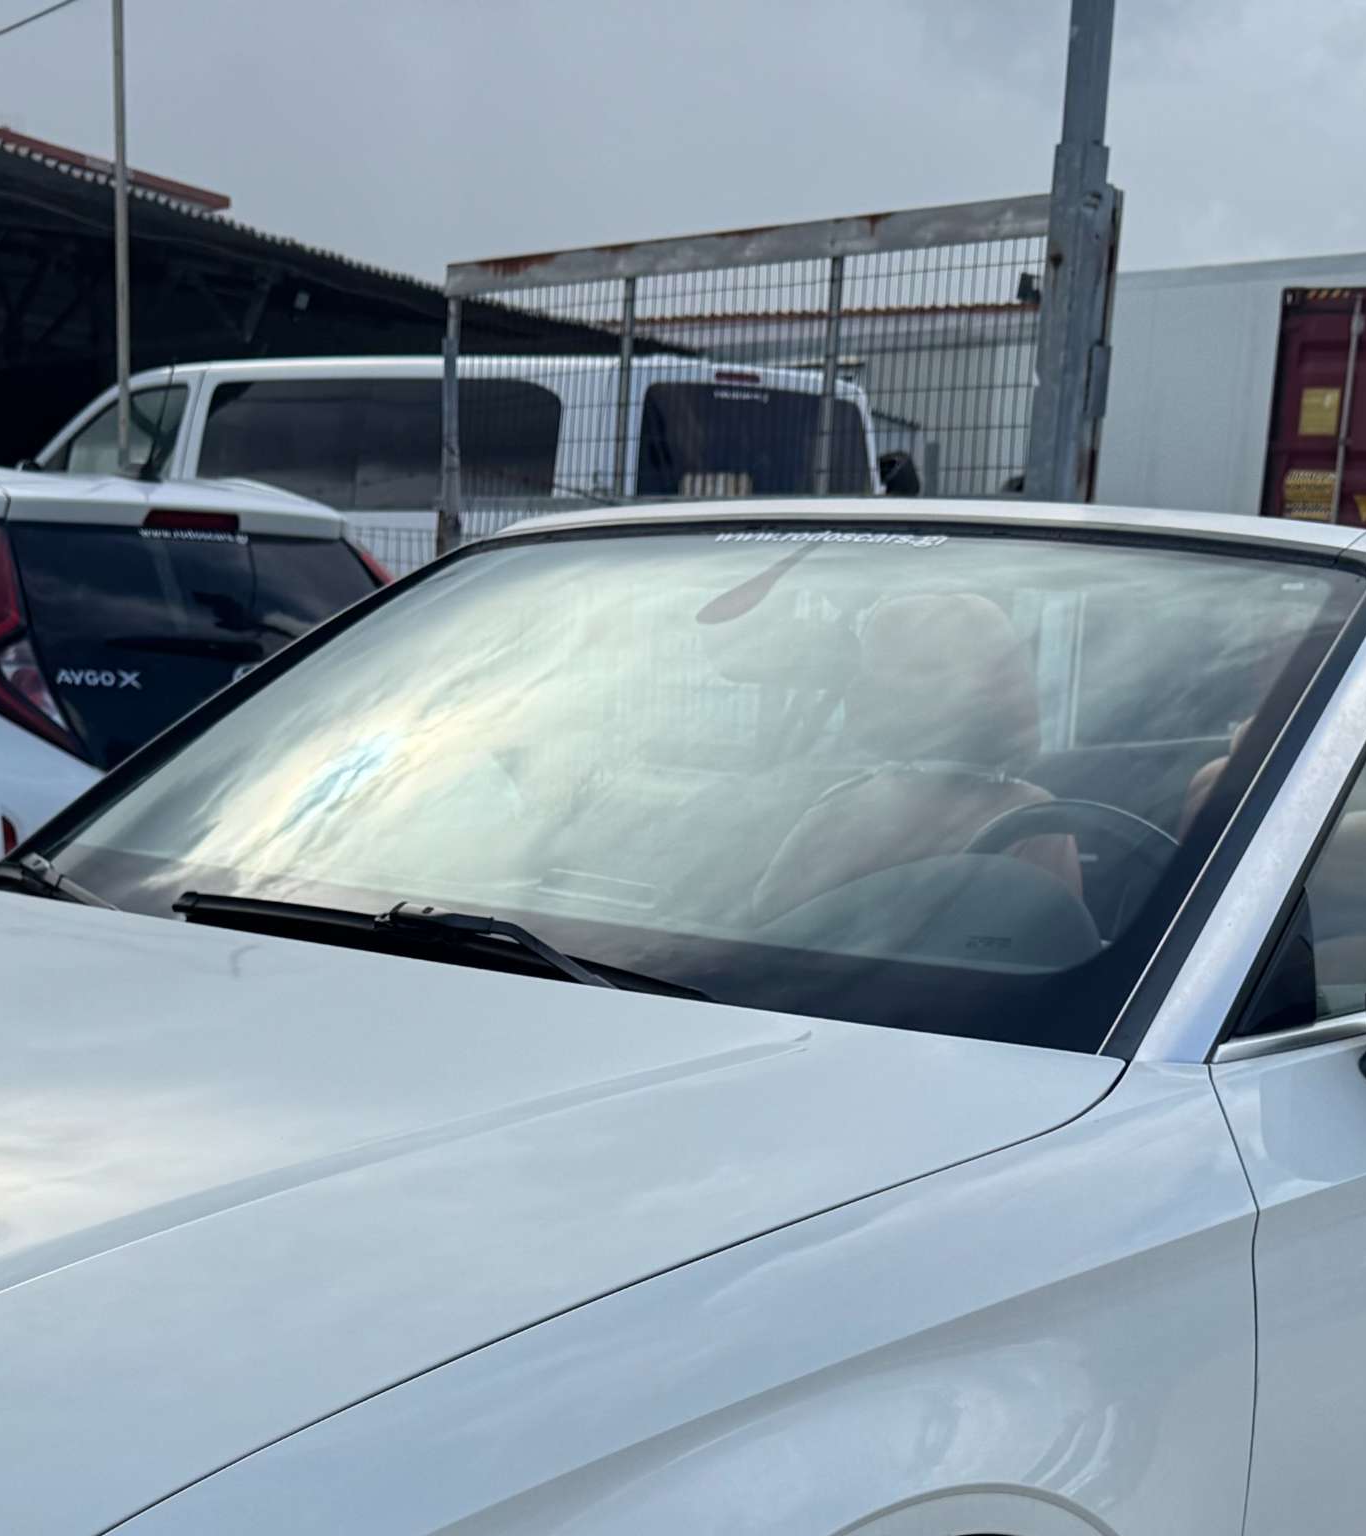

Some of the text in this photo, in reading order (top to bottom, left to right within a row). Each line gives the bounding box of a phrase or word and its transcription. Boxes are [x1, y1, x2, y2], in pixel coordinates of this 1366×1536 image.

[715, 530, 948, 548] www.rodoscars.gr
[56, 668, 142, 690] AYGO X
